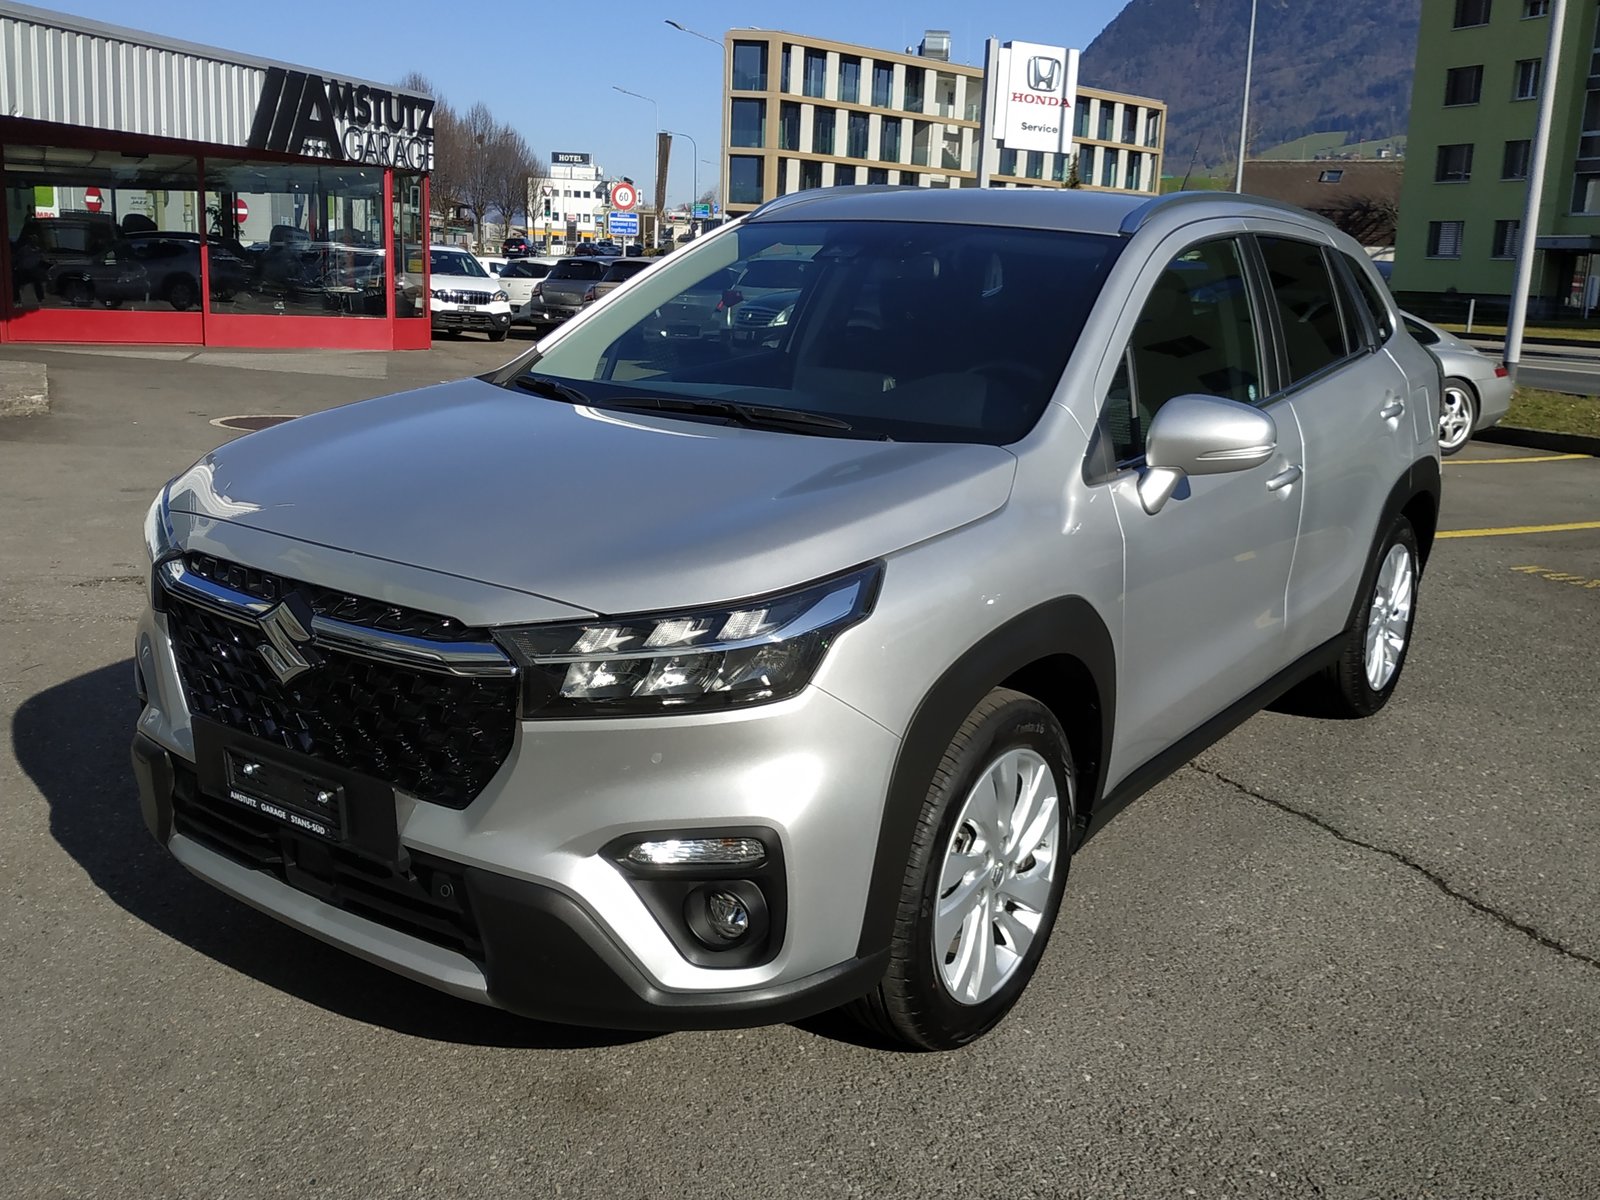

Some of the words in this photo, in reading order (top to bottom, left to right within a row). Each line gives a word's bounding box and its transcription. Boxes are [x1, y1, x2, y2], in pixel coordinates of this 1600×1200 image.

[1011, 92, 1071, 108] HONDA
[287, 73, 435, 161] AMSTUTZ
[1021, 122, 1058, 133] Service
[342, 126, 435, 171] GARAGE
[558, 154, 583, 162] HOTEL
[618, 191, 629, 202] 60
[230, 791, 257, 807] AMSTUTZ
[261, 803, 287, 819] GARAGE
